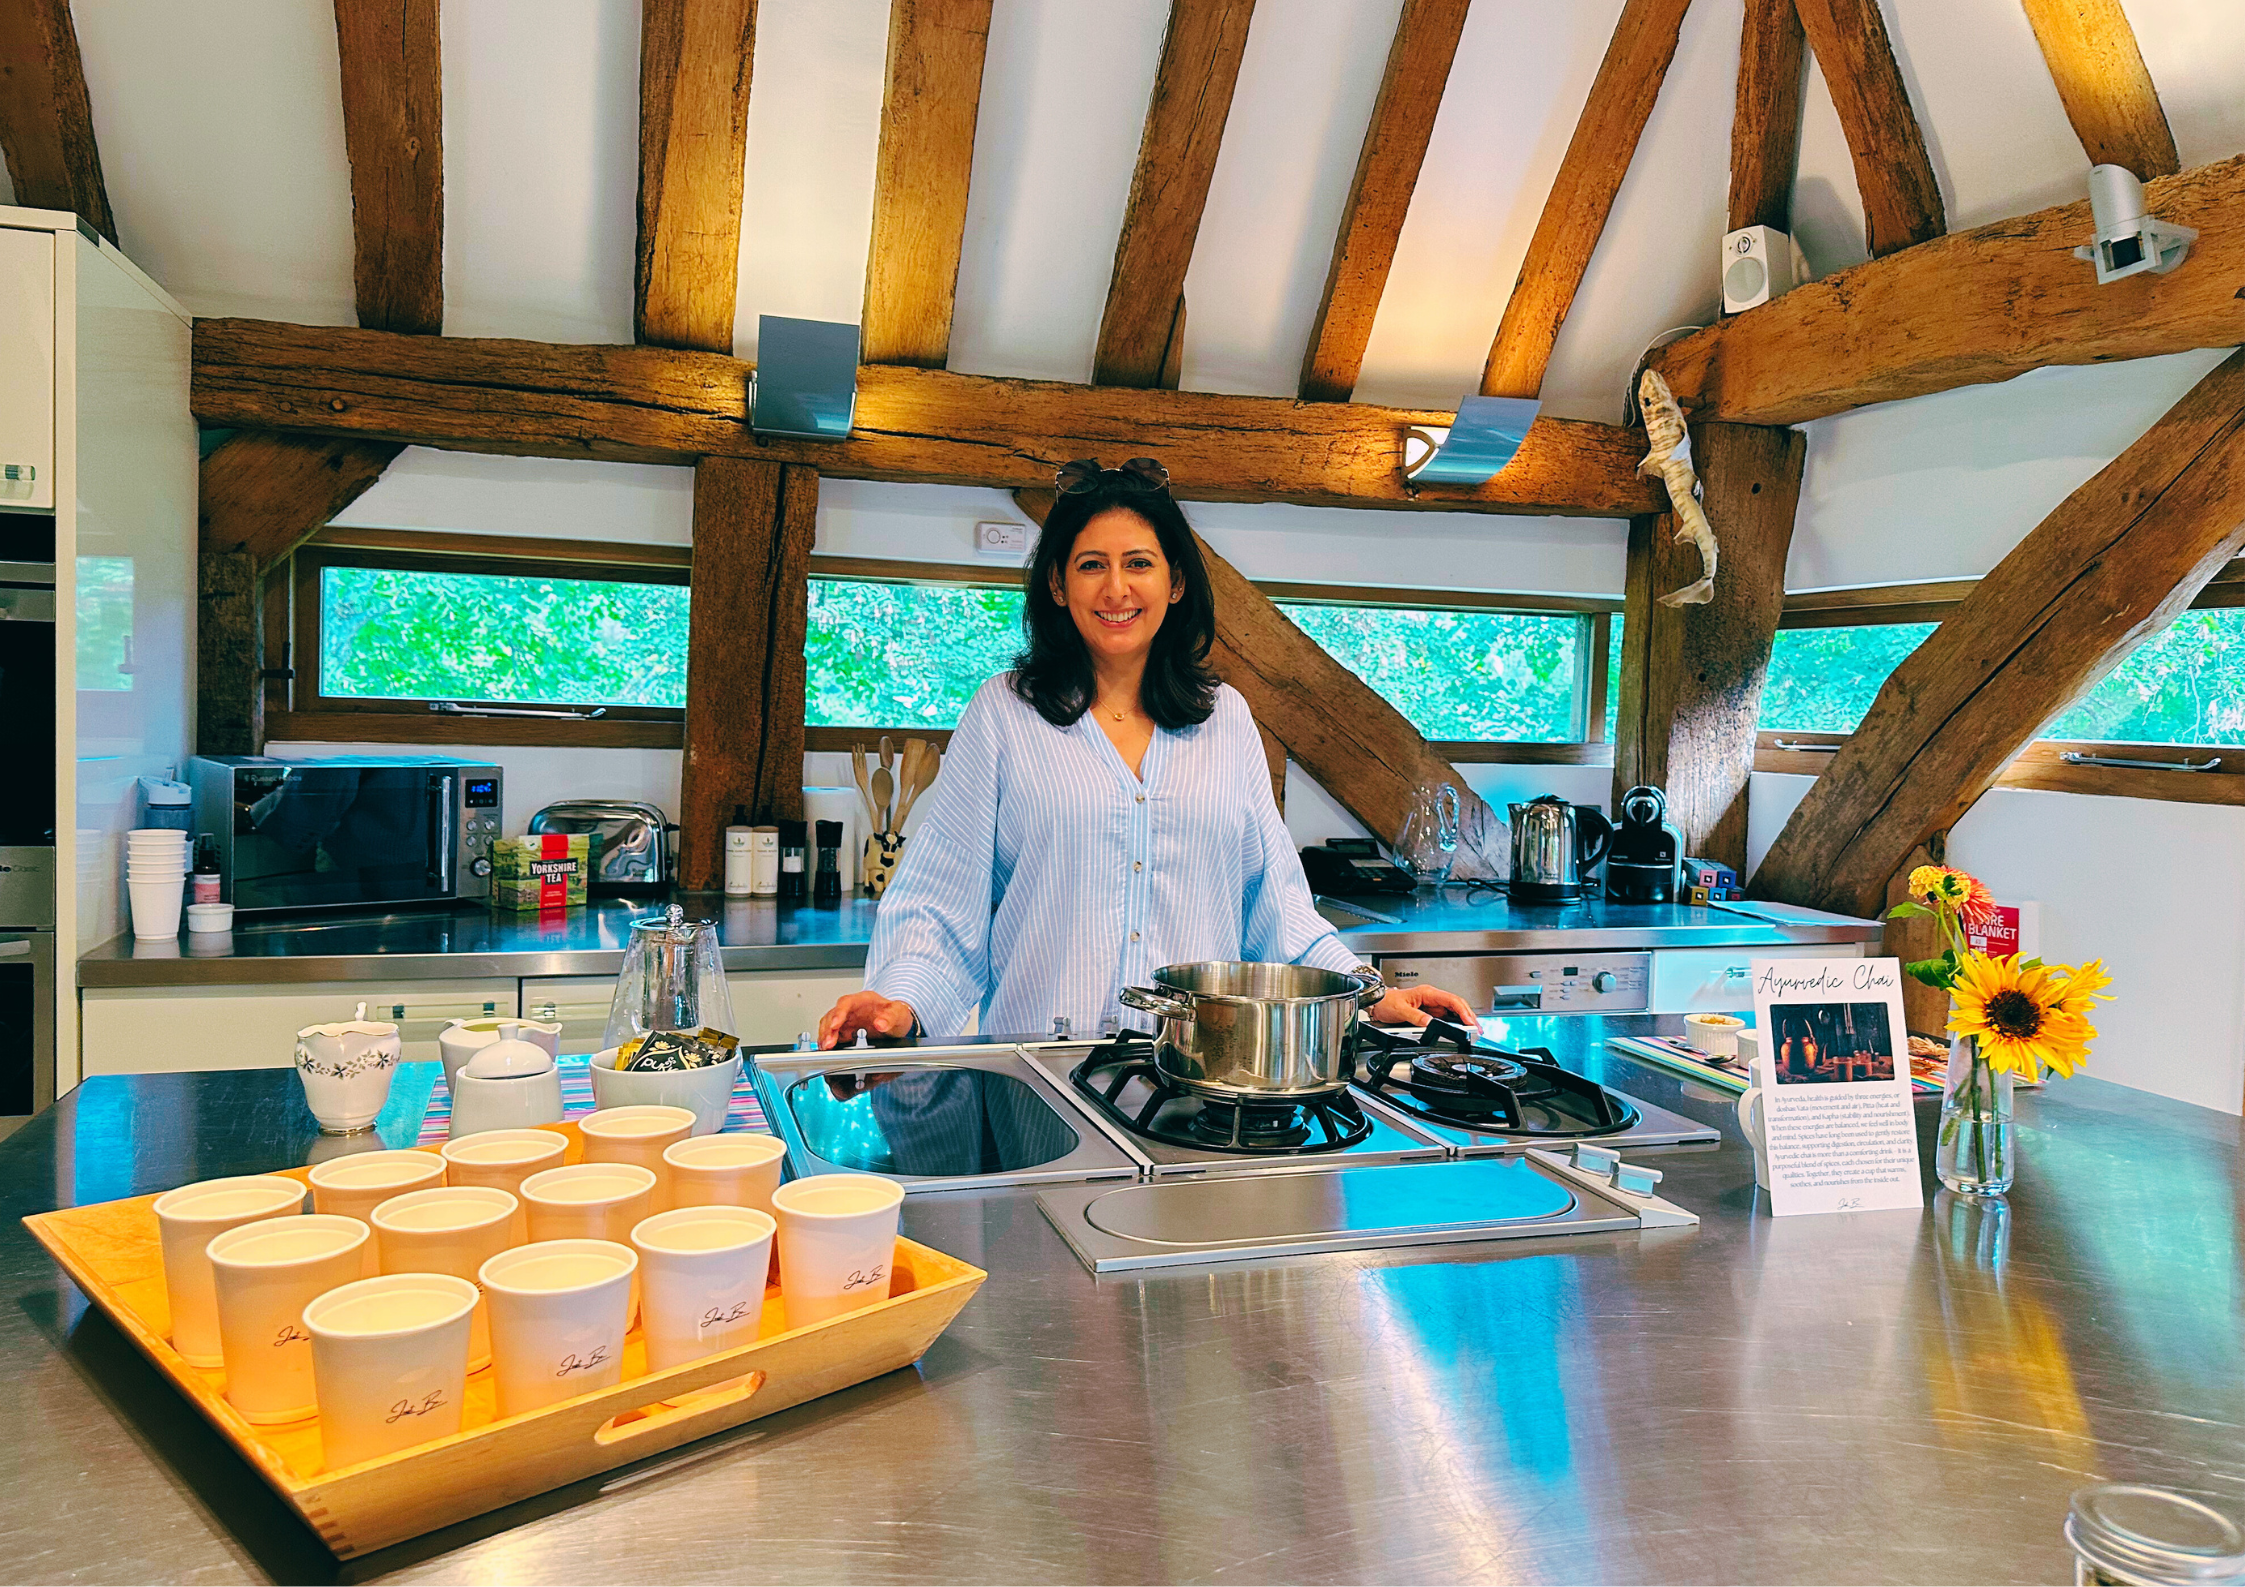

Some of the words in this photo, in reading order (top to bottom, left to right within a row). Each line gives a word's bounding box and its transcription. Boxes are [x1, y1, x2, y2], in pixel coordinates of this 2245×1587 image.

[531, 862, 577, 874] YORKSHIRE
[546, 873, 562, 883] TEA
[1968, 923, 2017, 940] BLANKET
[1758, 966, 1844, 998] Ayurvedic
[1853, 964, 1894, 990] Chai
